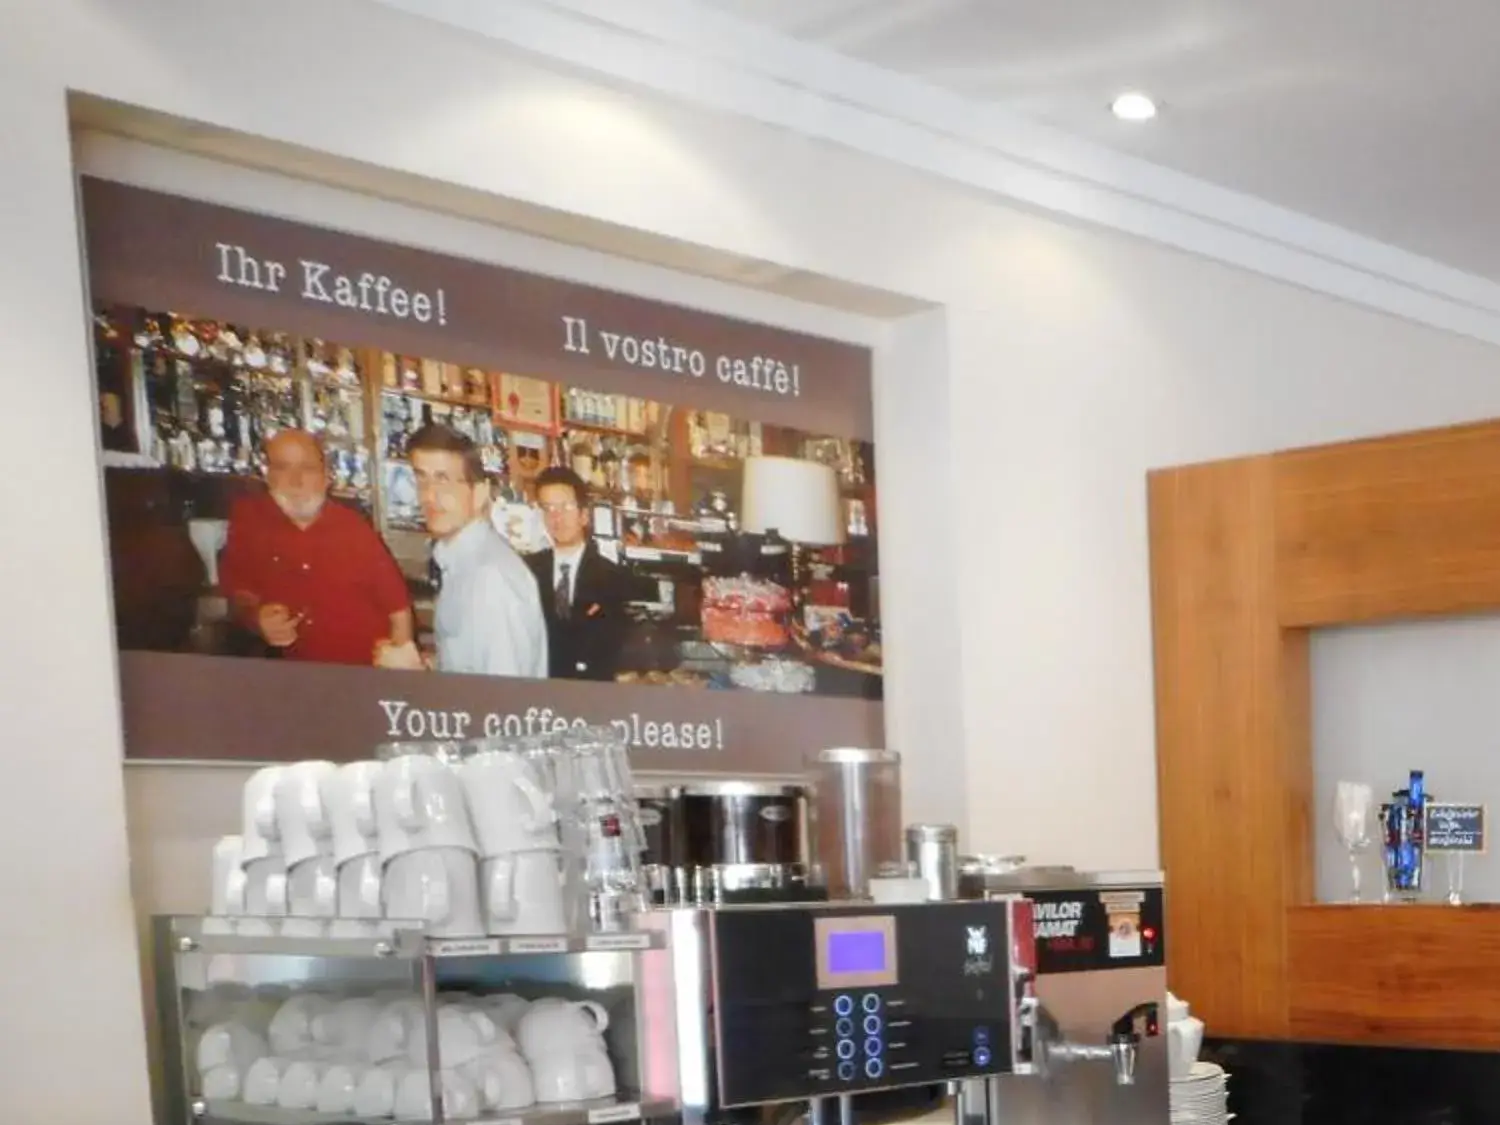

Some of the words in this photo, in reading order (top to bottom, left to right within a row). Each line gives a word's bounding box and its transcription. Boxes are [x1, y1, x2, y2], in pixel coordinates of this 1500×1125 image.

[215, 242, 285, 292] Ihr
[299, 259, 447, 326] Kaffee!
[562, 316, 590, 354] Il
[600, 330, 706, 377] vostro
[716, 354, 801, 396] caffè!
[379, 699, 472, 739] Your
